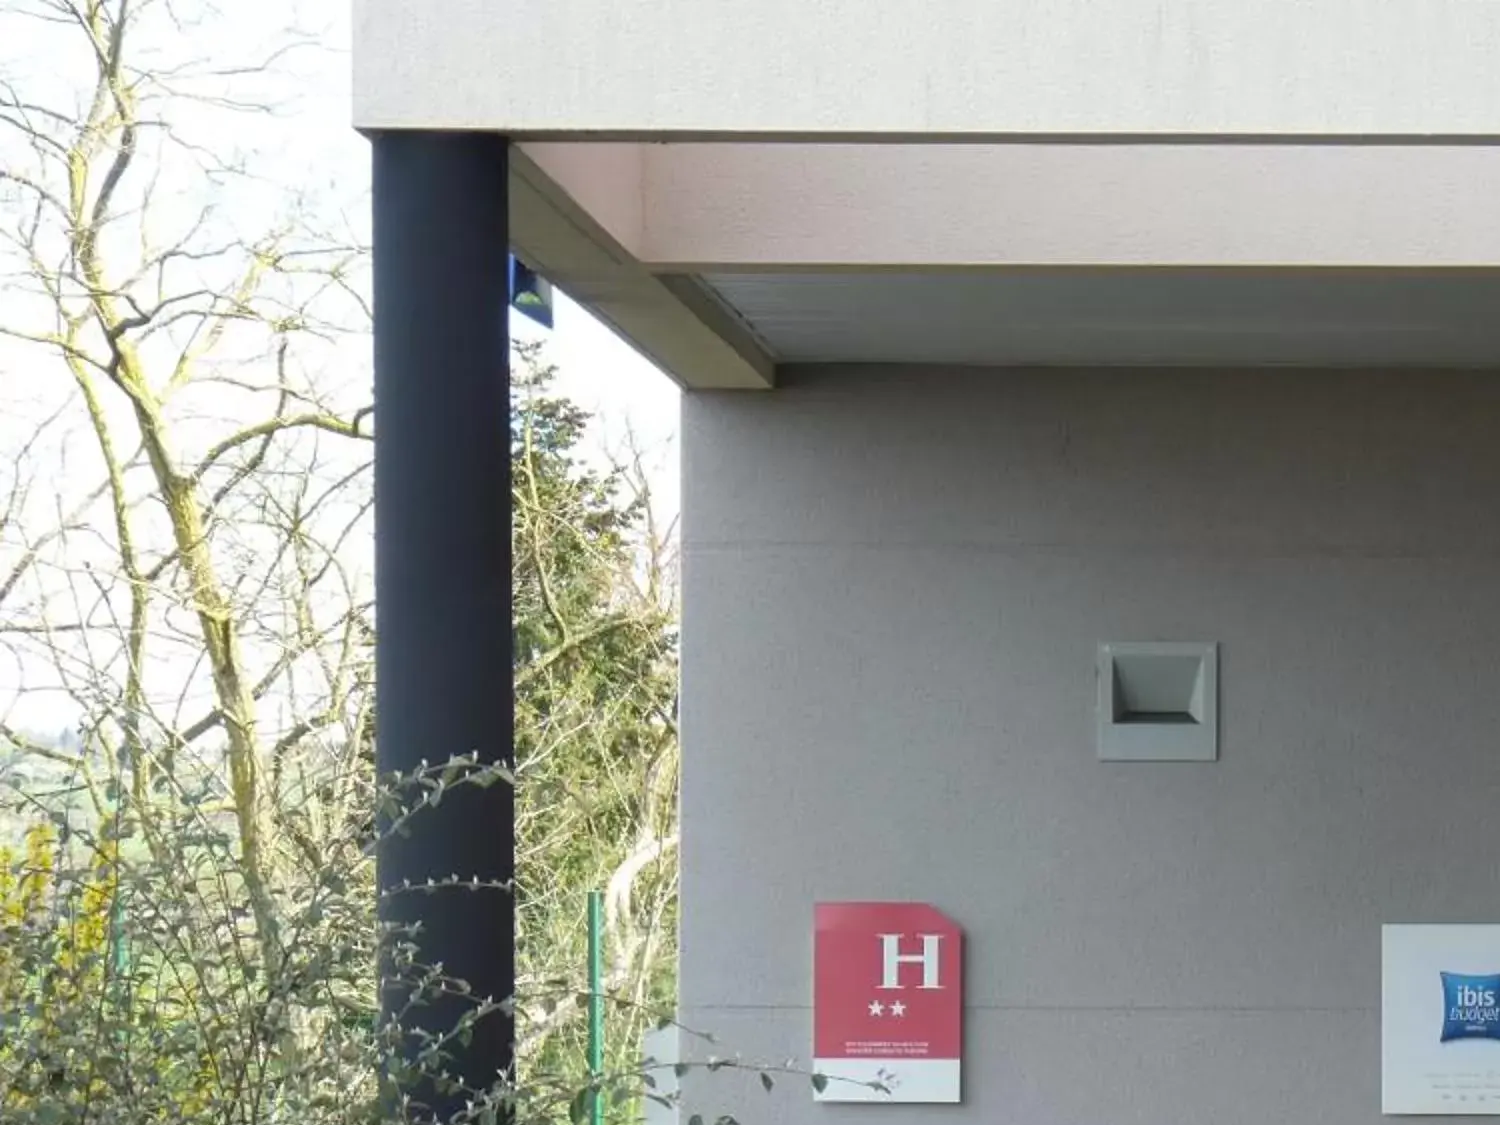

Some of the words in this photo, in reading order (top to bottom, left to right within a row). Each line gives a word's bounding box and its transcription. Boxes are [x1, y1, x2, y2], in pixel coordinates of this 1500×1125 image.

[875, 933, 946, 989] H
[1457, 985, 1496, 1006] ibis
[1449, 1006, 1500, 1024] budget
